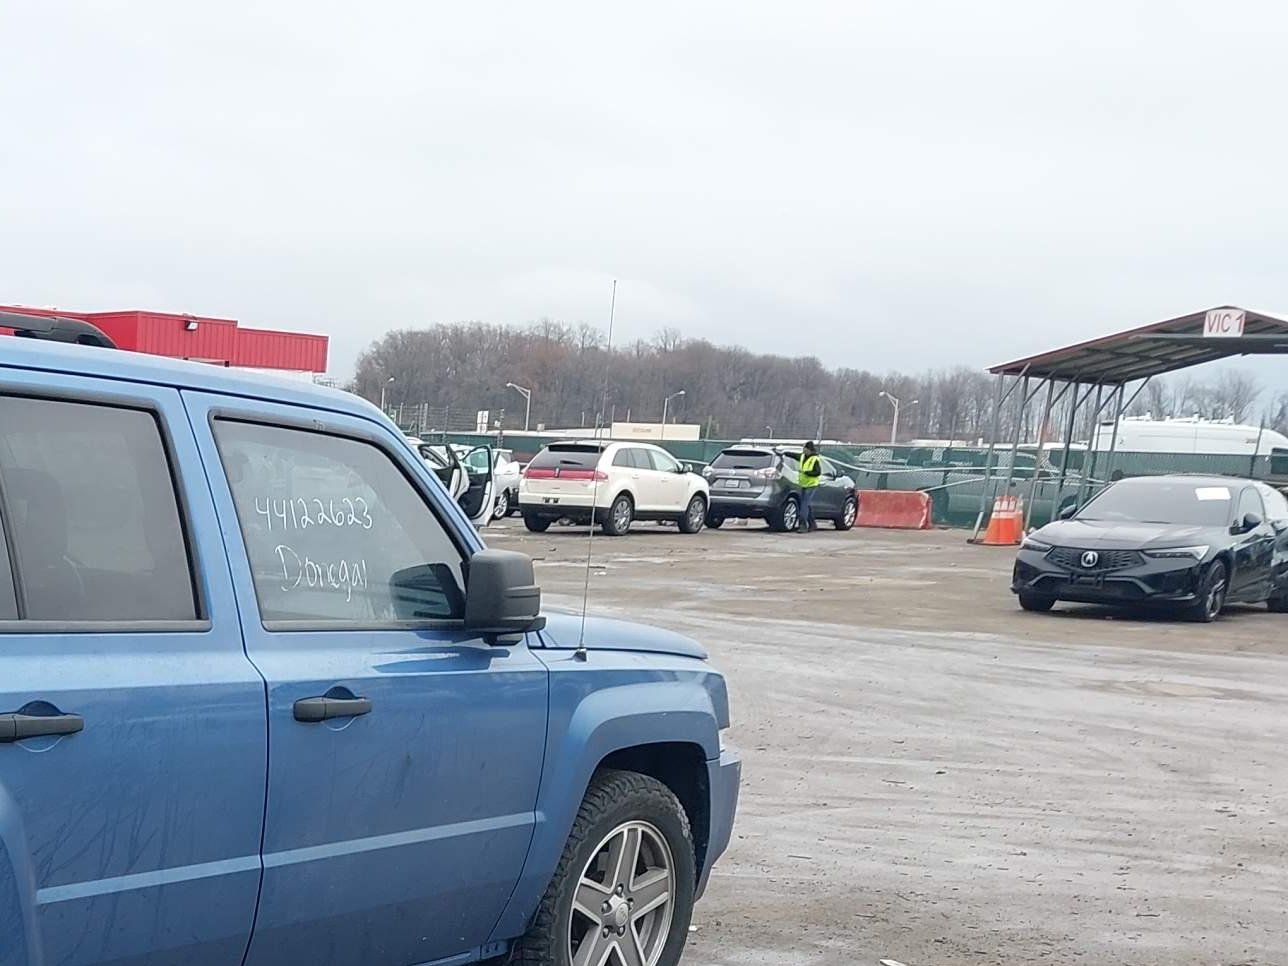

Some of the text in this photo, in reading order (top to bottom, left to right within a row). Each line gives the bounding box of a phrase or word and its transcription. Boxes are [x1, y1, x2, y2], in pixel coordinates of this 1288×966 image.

[1207, 312, 1244, 333] VIC 1
[255, 496, 373, 532] 44122623
[274, 544, 368, 603] Donegal
